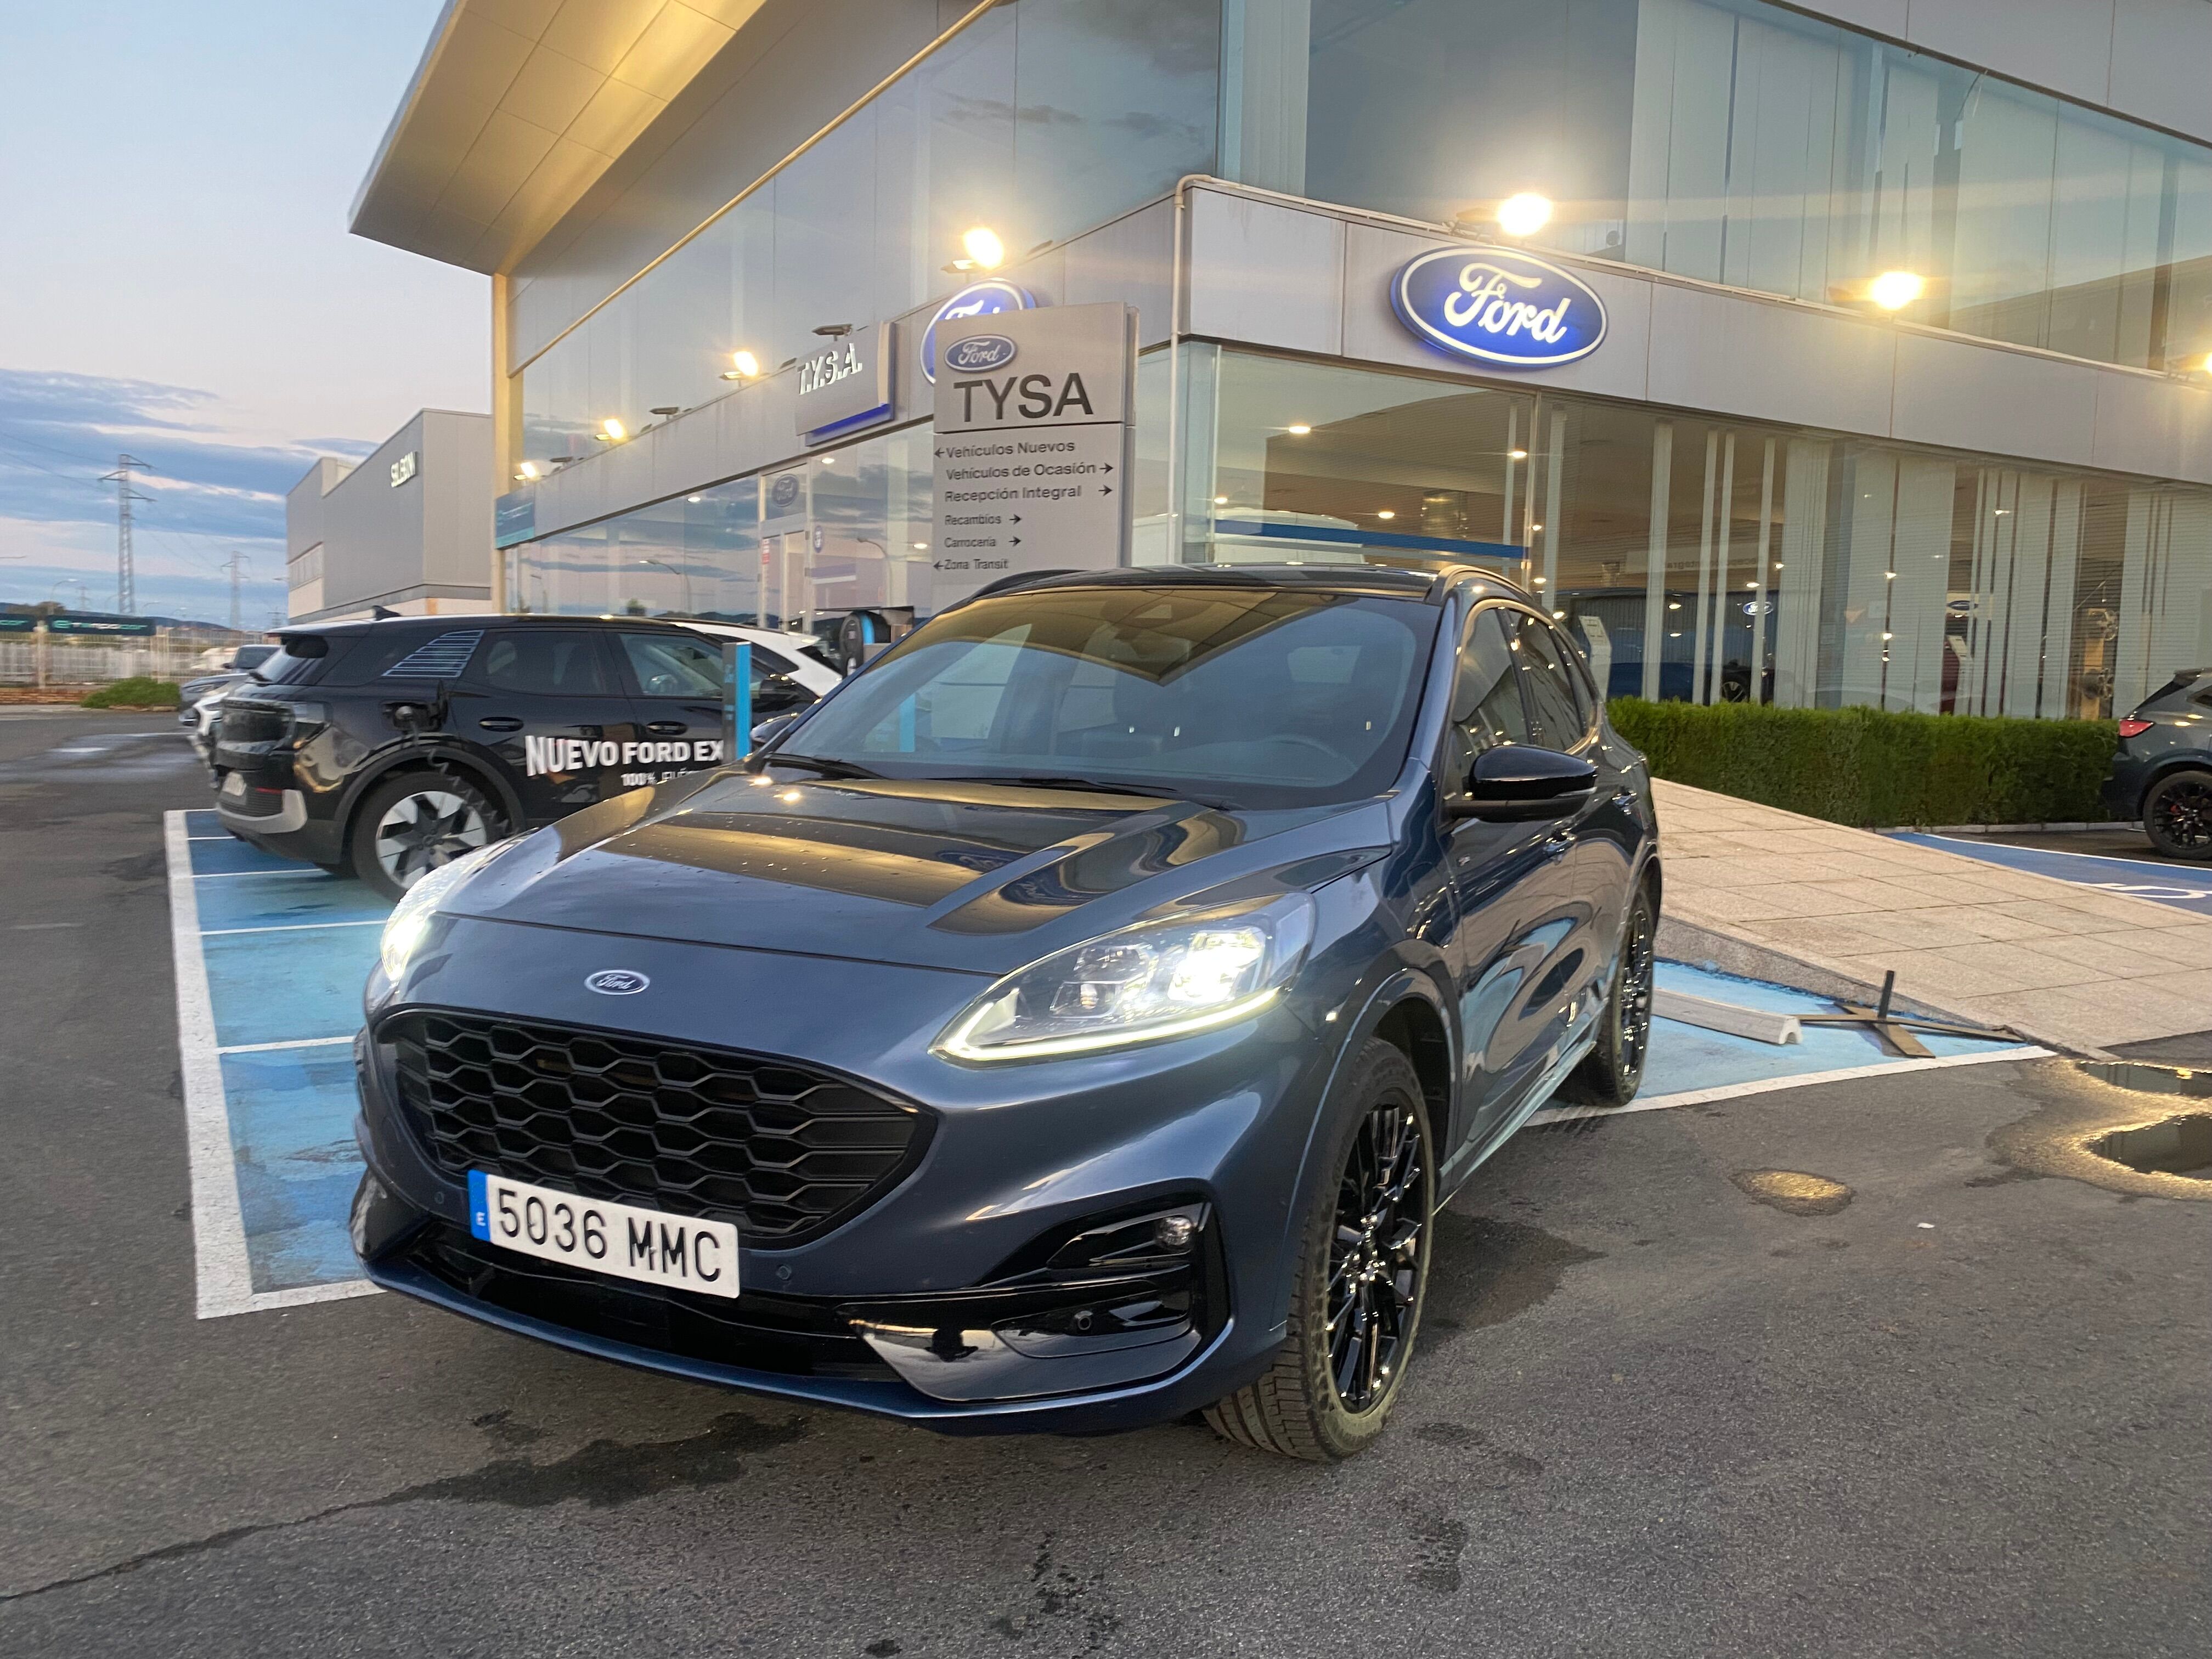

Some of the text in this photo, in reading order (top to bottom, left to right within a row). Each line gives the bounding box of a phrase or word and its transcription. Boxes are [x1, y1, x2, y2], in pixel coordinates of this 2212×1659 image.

[1444, 262, 1571, 343] Ford
[958, 341, 1001, 364] Ford
[953, 373, 1094, 422] TYSA
[946, 442, 1075, 458] Vehículos Nuevos
[946, 461, 1096, 480] Vehículos de Ocasión
[944, 485, 1082, 503] Recepción Integral
[945, 514, 1002, 525] Recambios
[944, 558, 1009, 570] Zona Transit
[525, 735, 619, 776] NUEVO
[622, 741, 691, 764] FORD
[620, 771, 657, 786] 100%
[596, 974, 636, 990] Ford
[476, 1211, 486, 1227] E
[498, 1188, 721, 1282] 5036 MMC
